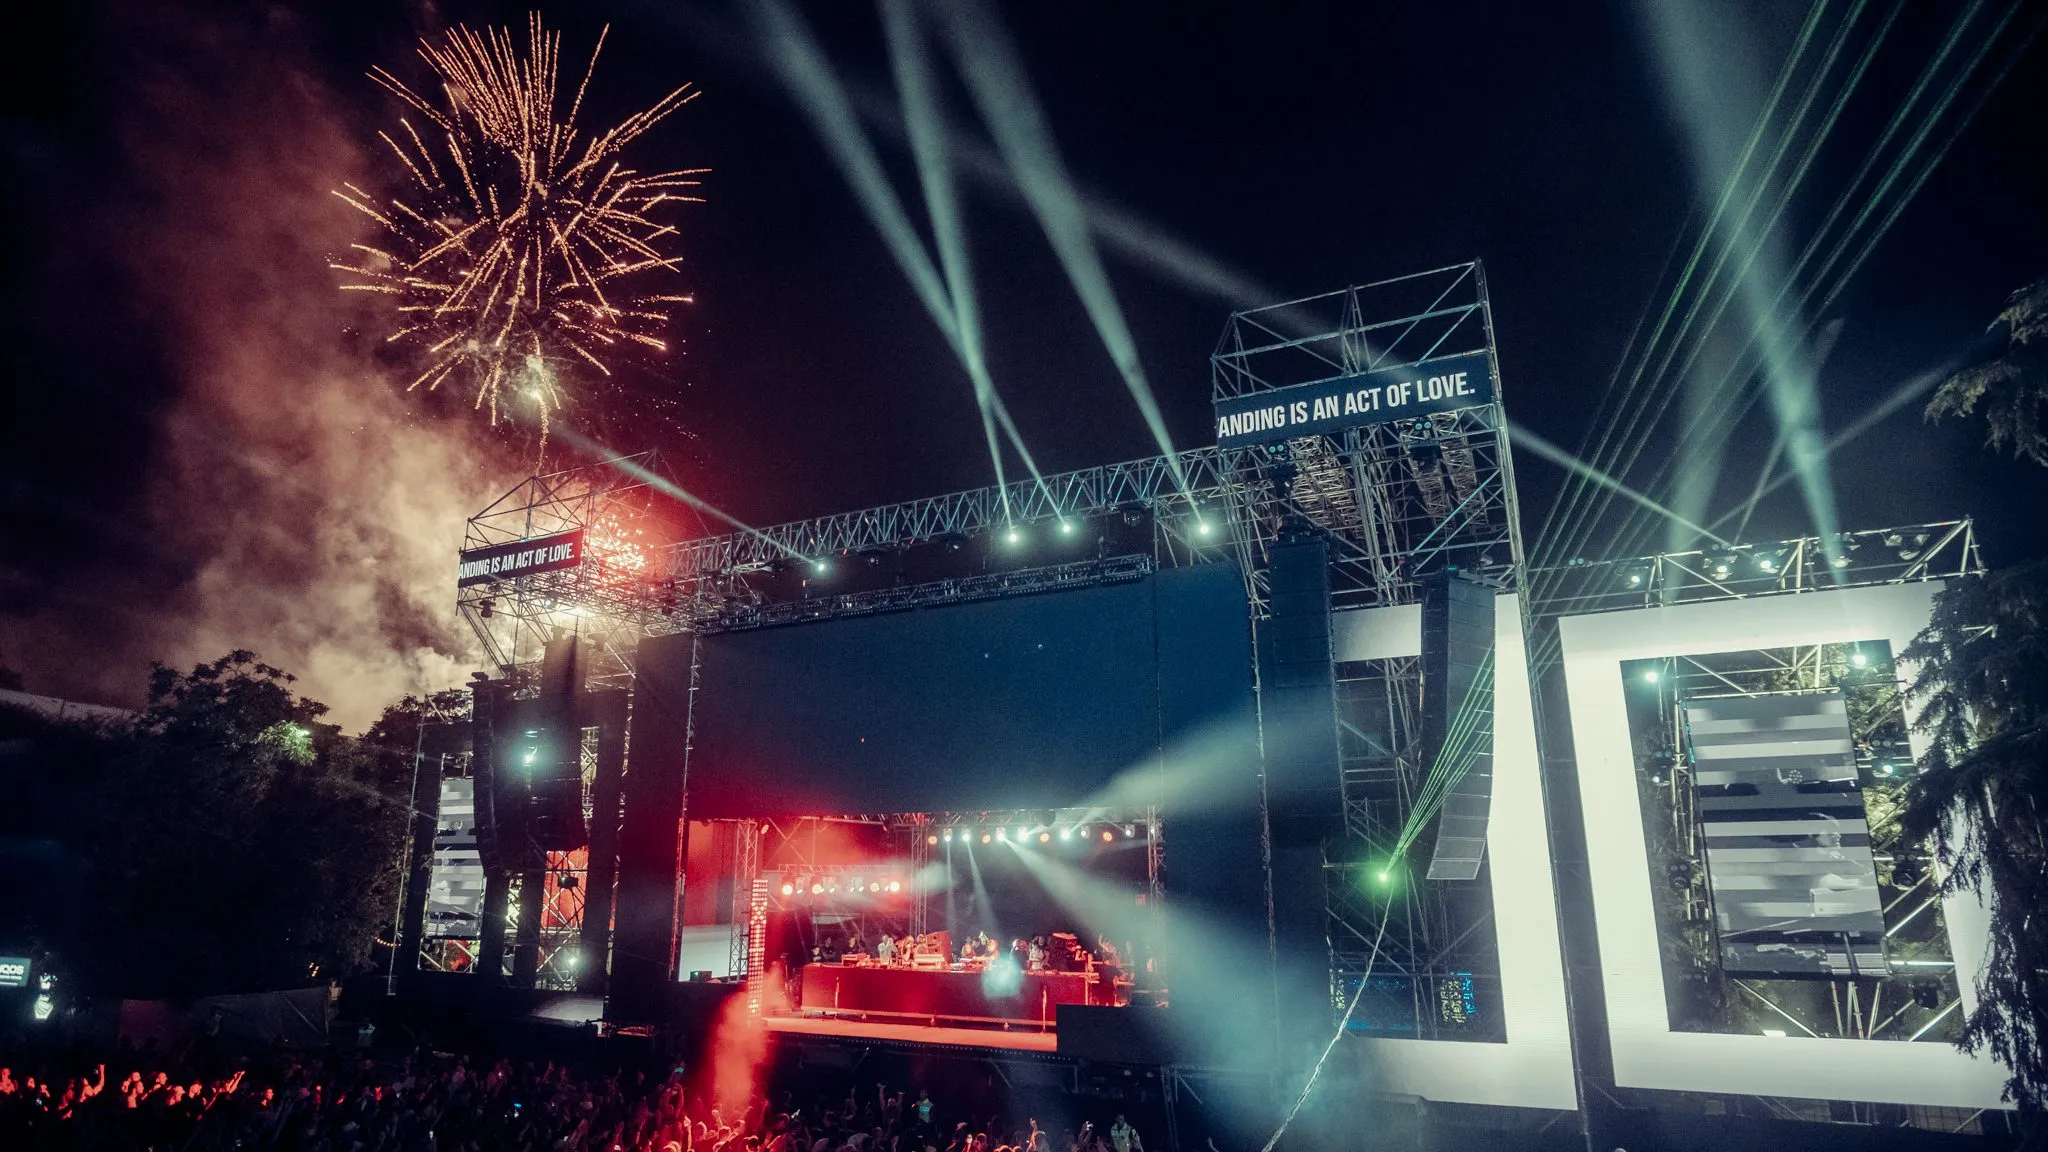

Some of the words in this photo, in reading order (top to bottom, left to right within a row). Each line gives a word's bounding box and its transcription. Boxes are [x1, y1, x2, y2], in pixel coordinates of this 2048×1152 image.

[1218, 406, 1286, 438] ANDING
[1290, 401, 1308, 424] IS
[1313, 396, 1340, 421] AN
[1344, 387, 1381, 415] ACT
[1386, 382, 1411, 407] OF
[1416, 372, 1475, 402] LOVE.
[459, 559, 490, 579] ANDING
[491, 557, 500, 574] IS
[501, 554, 515, 571] AN
[515, 550, 534, 569] ACT
[535, 548, 549, 564] OF
[549, 543, 575, 562] LOVE.
